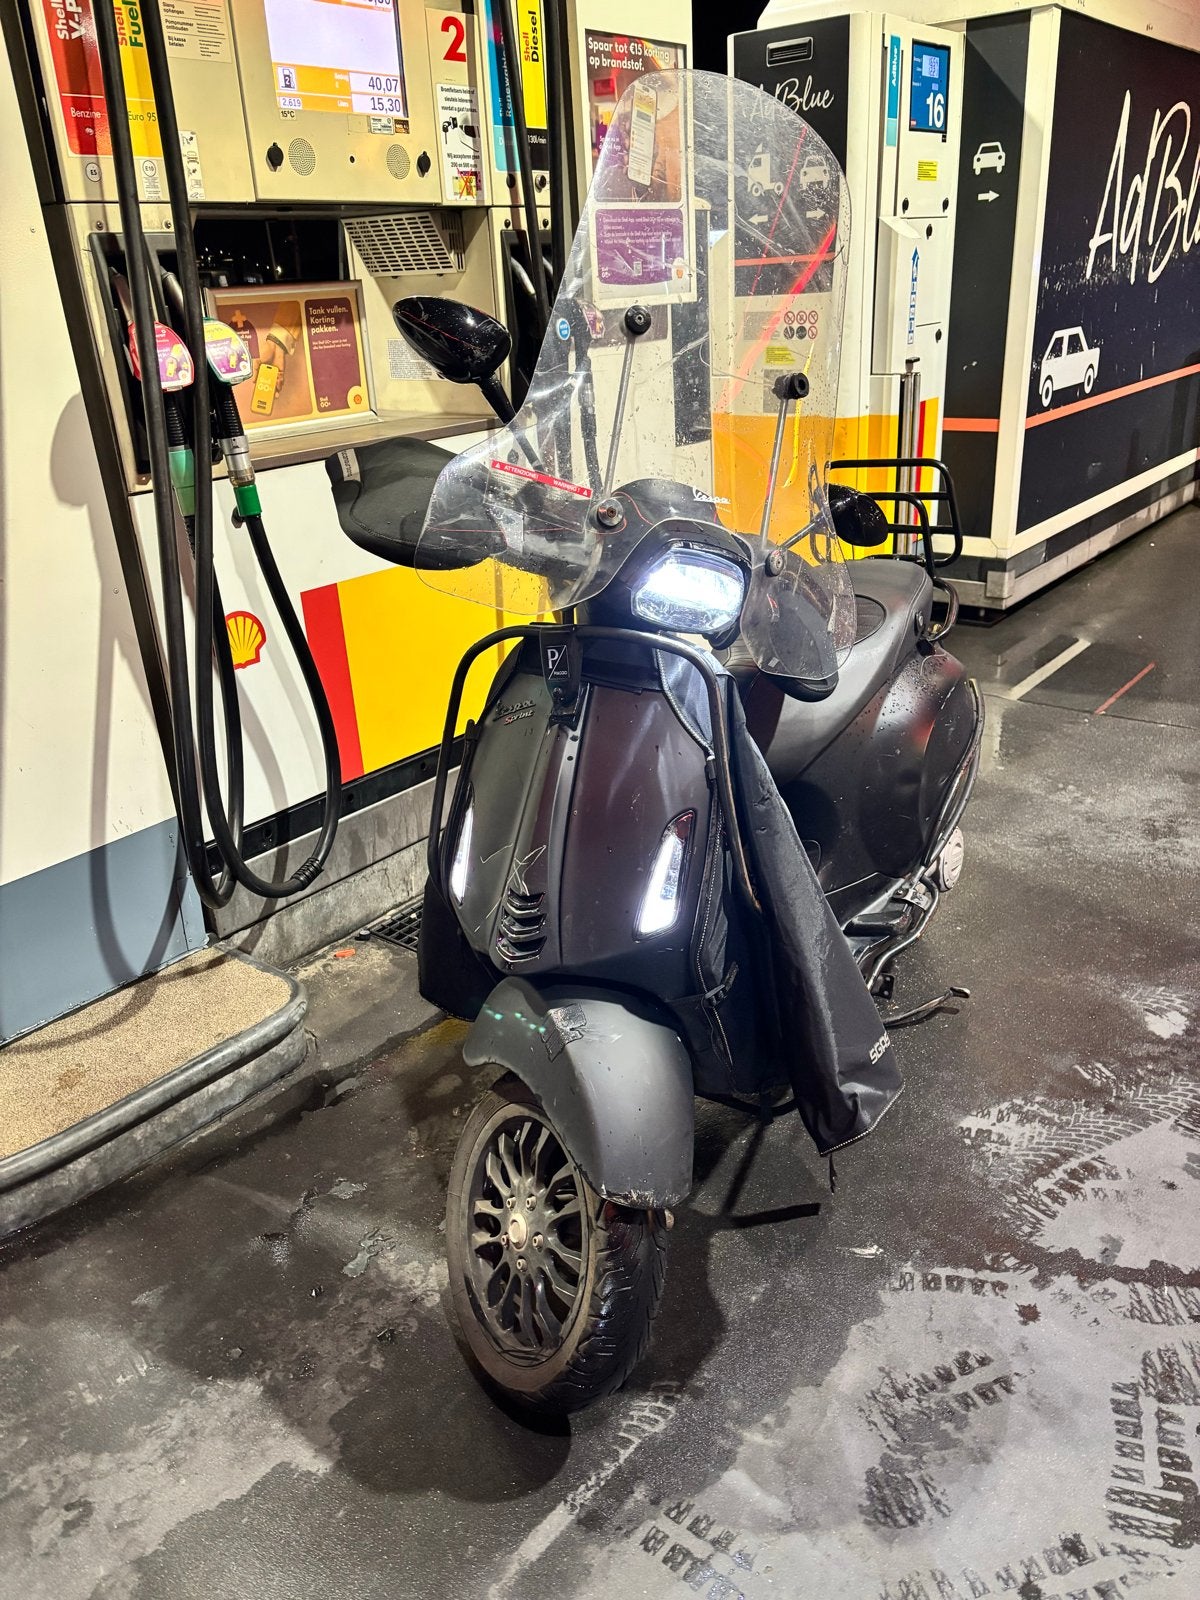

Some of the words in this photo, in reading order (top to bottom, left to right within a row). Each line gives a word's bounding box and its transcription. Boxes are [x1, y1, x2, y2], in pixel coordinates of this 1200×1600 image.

[51, 0, 69, 40] Shell
[114, 7, 127, 46] Shell
[122, 0, 143, 47] Fuel
[441, 16, 466, 62] 2
[522, 32, 530, 61] Shell
[528, 10, 539, 62] Diesel
[588, 38, 613, 56] Spaar
[615, 42, 628, 53] tot
[629, 44, 642, 56] €15
[644, 44, 669, 62] korting
[589, 56, 600, 70] op
[602, 57, 645, 72] brandstof.
[368, 76, 398, 93] 40,07
[70, 107, 101, 118] Benzine
[370, 97, 401, 114] 15,30
[926, 92, 945, 128] 16
[128, 111, 144, 121] Euro
[147, 112, 157, 122] 95
[1086, 89, 1200, 284] AdBl
[309, 307, 325, 315] Tank
[326, 305, 348, 314] vullen.
[310, 316, 335, 325] Korting
[311, 325, 338, 335] pakken.
[504, 465, 539, 479] ATTENZIONE!
[553, 479, 578, 492] WARNING
[692, 486, 731, 504] Vespa
[546, 648, 558, 669] P
[504, 710, 535, 725] Sprint
